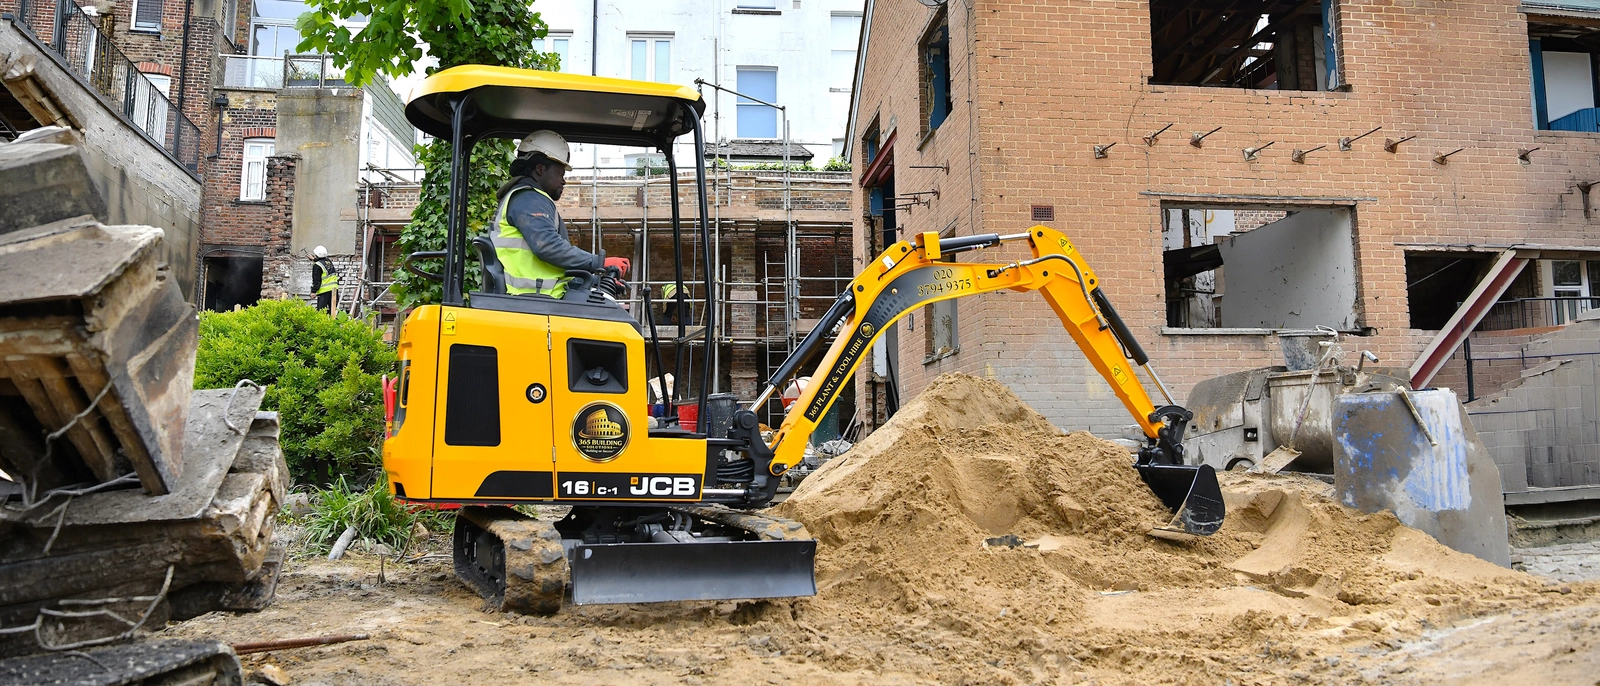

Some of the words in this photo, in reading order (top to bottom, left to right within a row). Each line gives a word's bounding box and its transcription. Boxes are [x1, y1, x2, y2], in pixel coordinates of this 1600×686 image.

[933, 268, 953, 281] 020
[917, 282, 944, 297] 3794
[945, 278, 971, 291] 9375
[849, 337, 864, 356] HIRE
[835, 356, 852, 375] TOOL
[831, 375, 840, 383] &
[816, 382, 835, 407] PLANT
[808, 406, 819, 419] 365
[562, 480, 590, 495] 16
[630, 476, 695, 496] JCB
